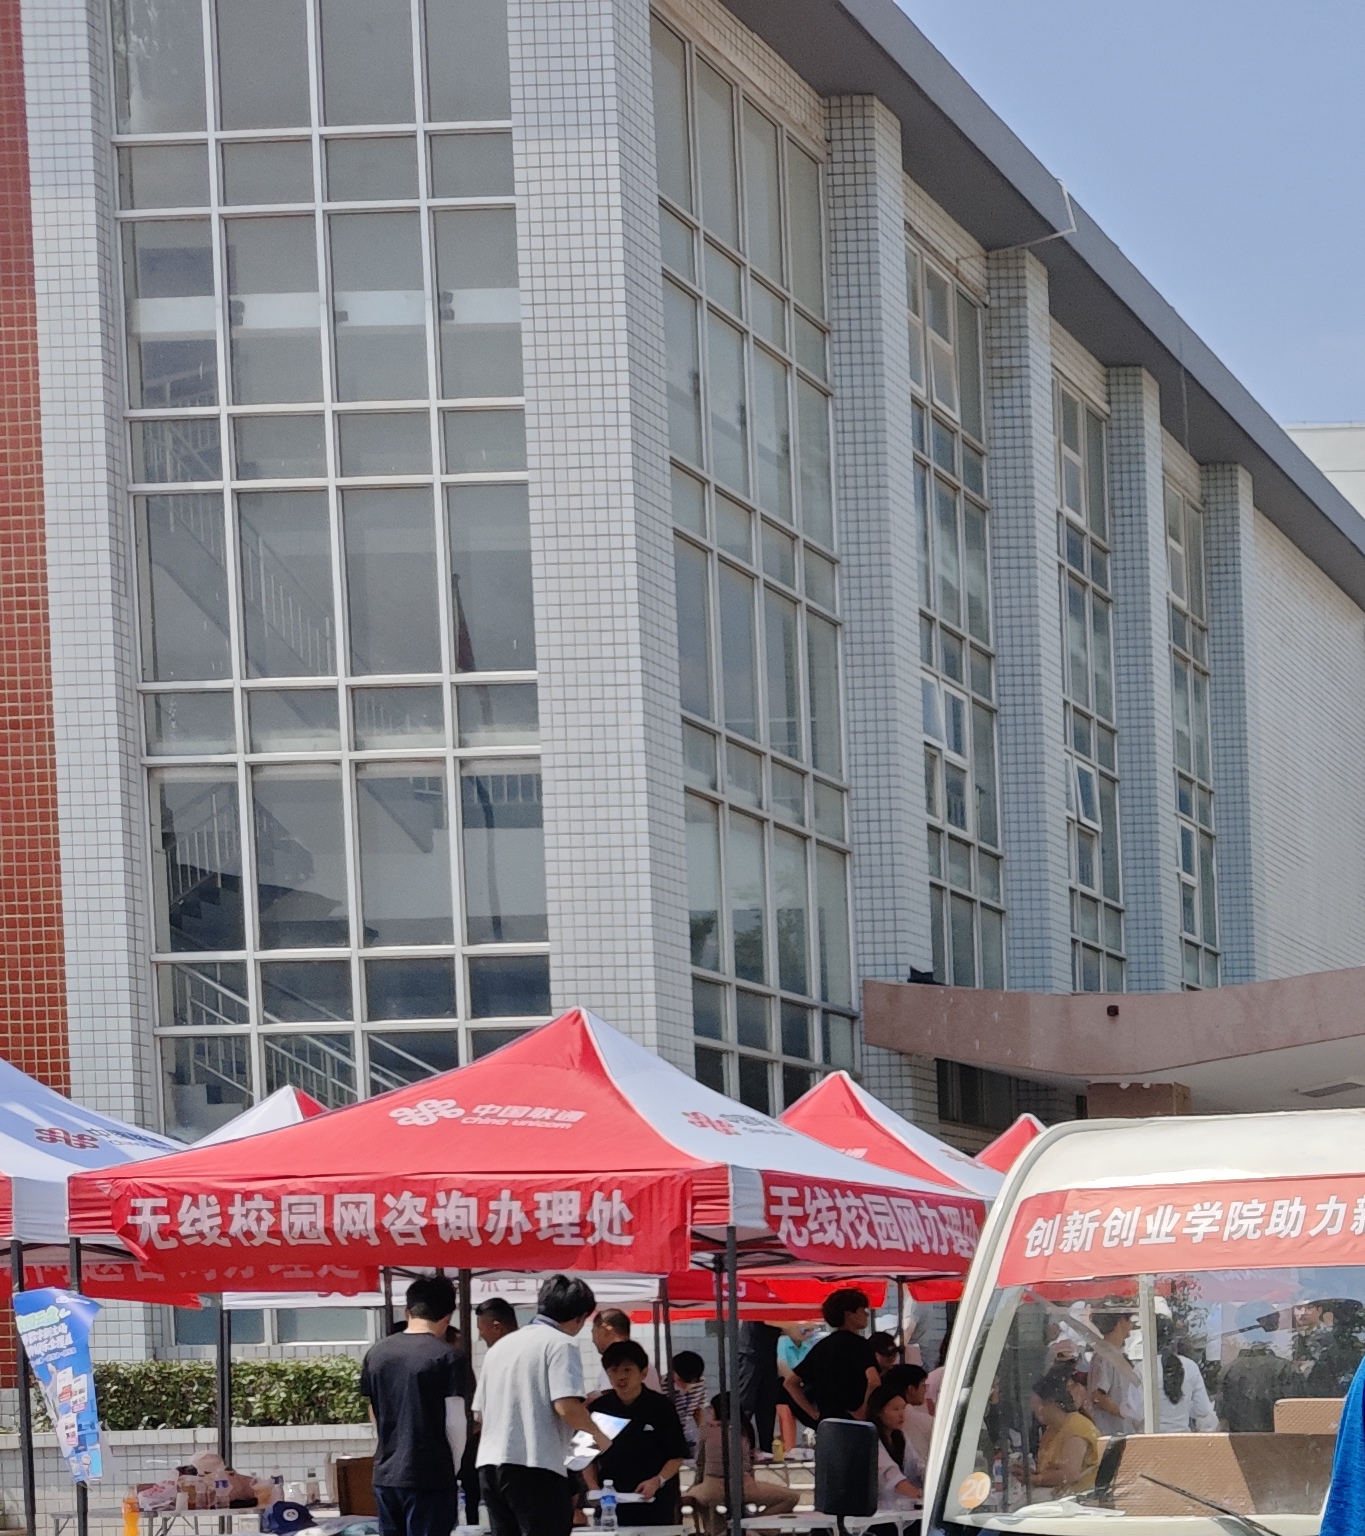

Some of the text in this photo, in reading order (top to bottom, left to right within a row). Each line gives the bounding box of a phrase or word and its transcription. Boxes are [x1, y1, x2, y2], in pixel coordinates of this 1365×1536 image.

[472, 1103, 587, 1123] 中国联通
[511, 1119, 573, 1130] unicom
[127, 1189, 634, 1249] 无线校园网咨询办理处
[961, 1479, 988, 1500] 20
